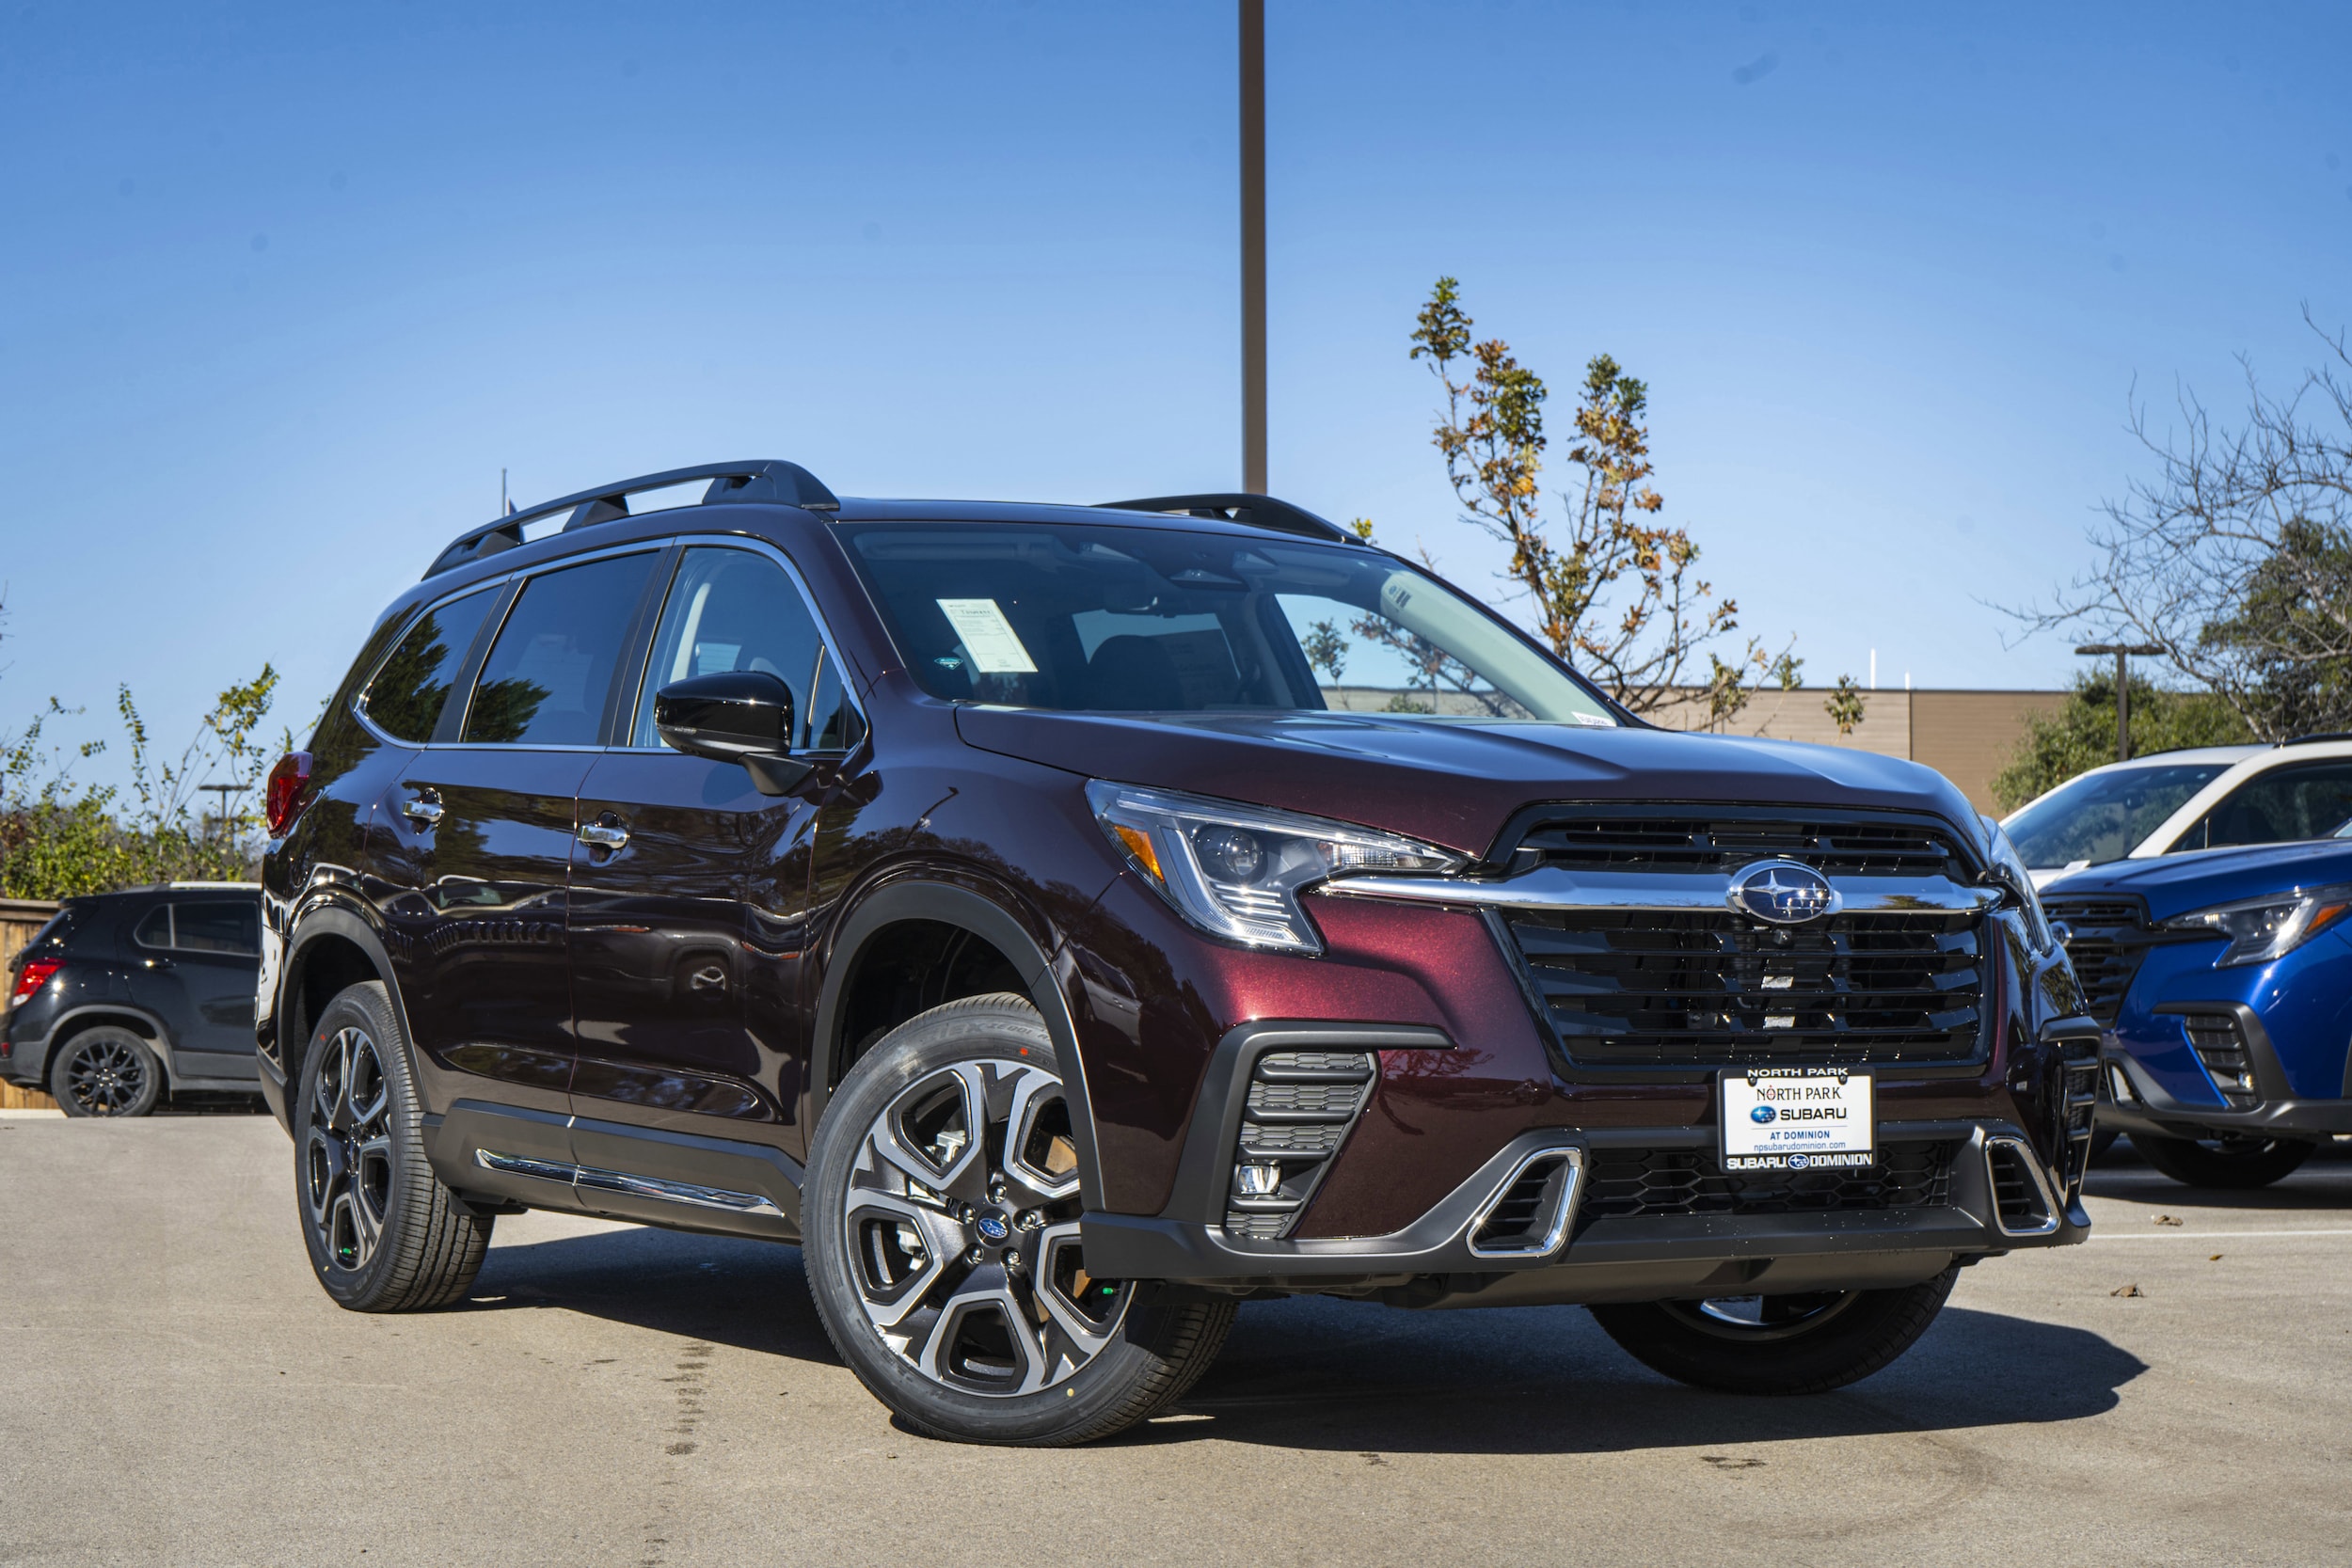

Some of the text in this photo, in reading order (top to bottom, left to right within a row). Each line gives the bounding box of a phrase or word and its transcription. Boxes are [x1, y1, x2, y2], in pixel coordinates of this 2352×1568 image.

[1747, 1067, 1849, 1078] NORTH PARK
[1756, 1085, 1842, 1101] NORTH PARK
[1780, 1107, 1848, 1121] SUBARU
[1770, 1130, 1831, 1140] AT DOMINION
[1754, 1141, 1847, 1153] npsubarudominion.com
[1726, 1153, 1873, 1170] SUBARU DOMINION
